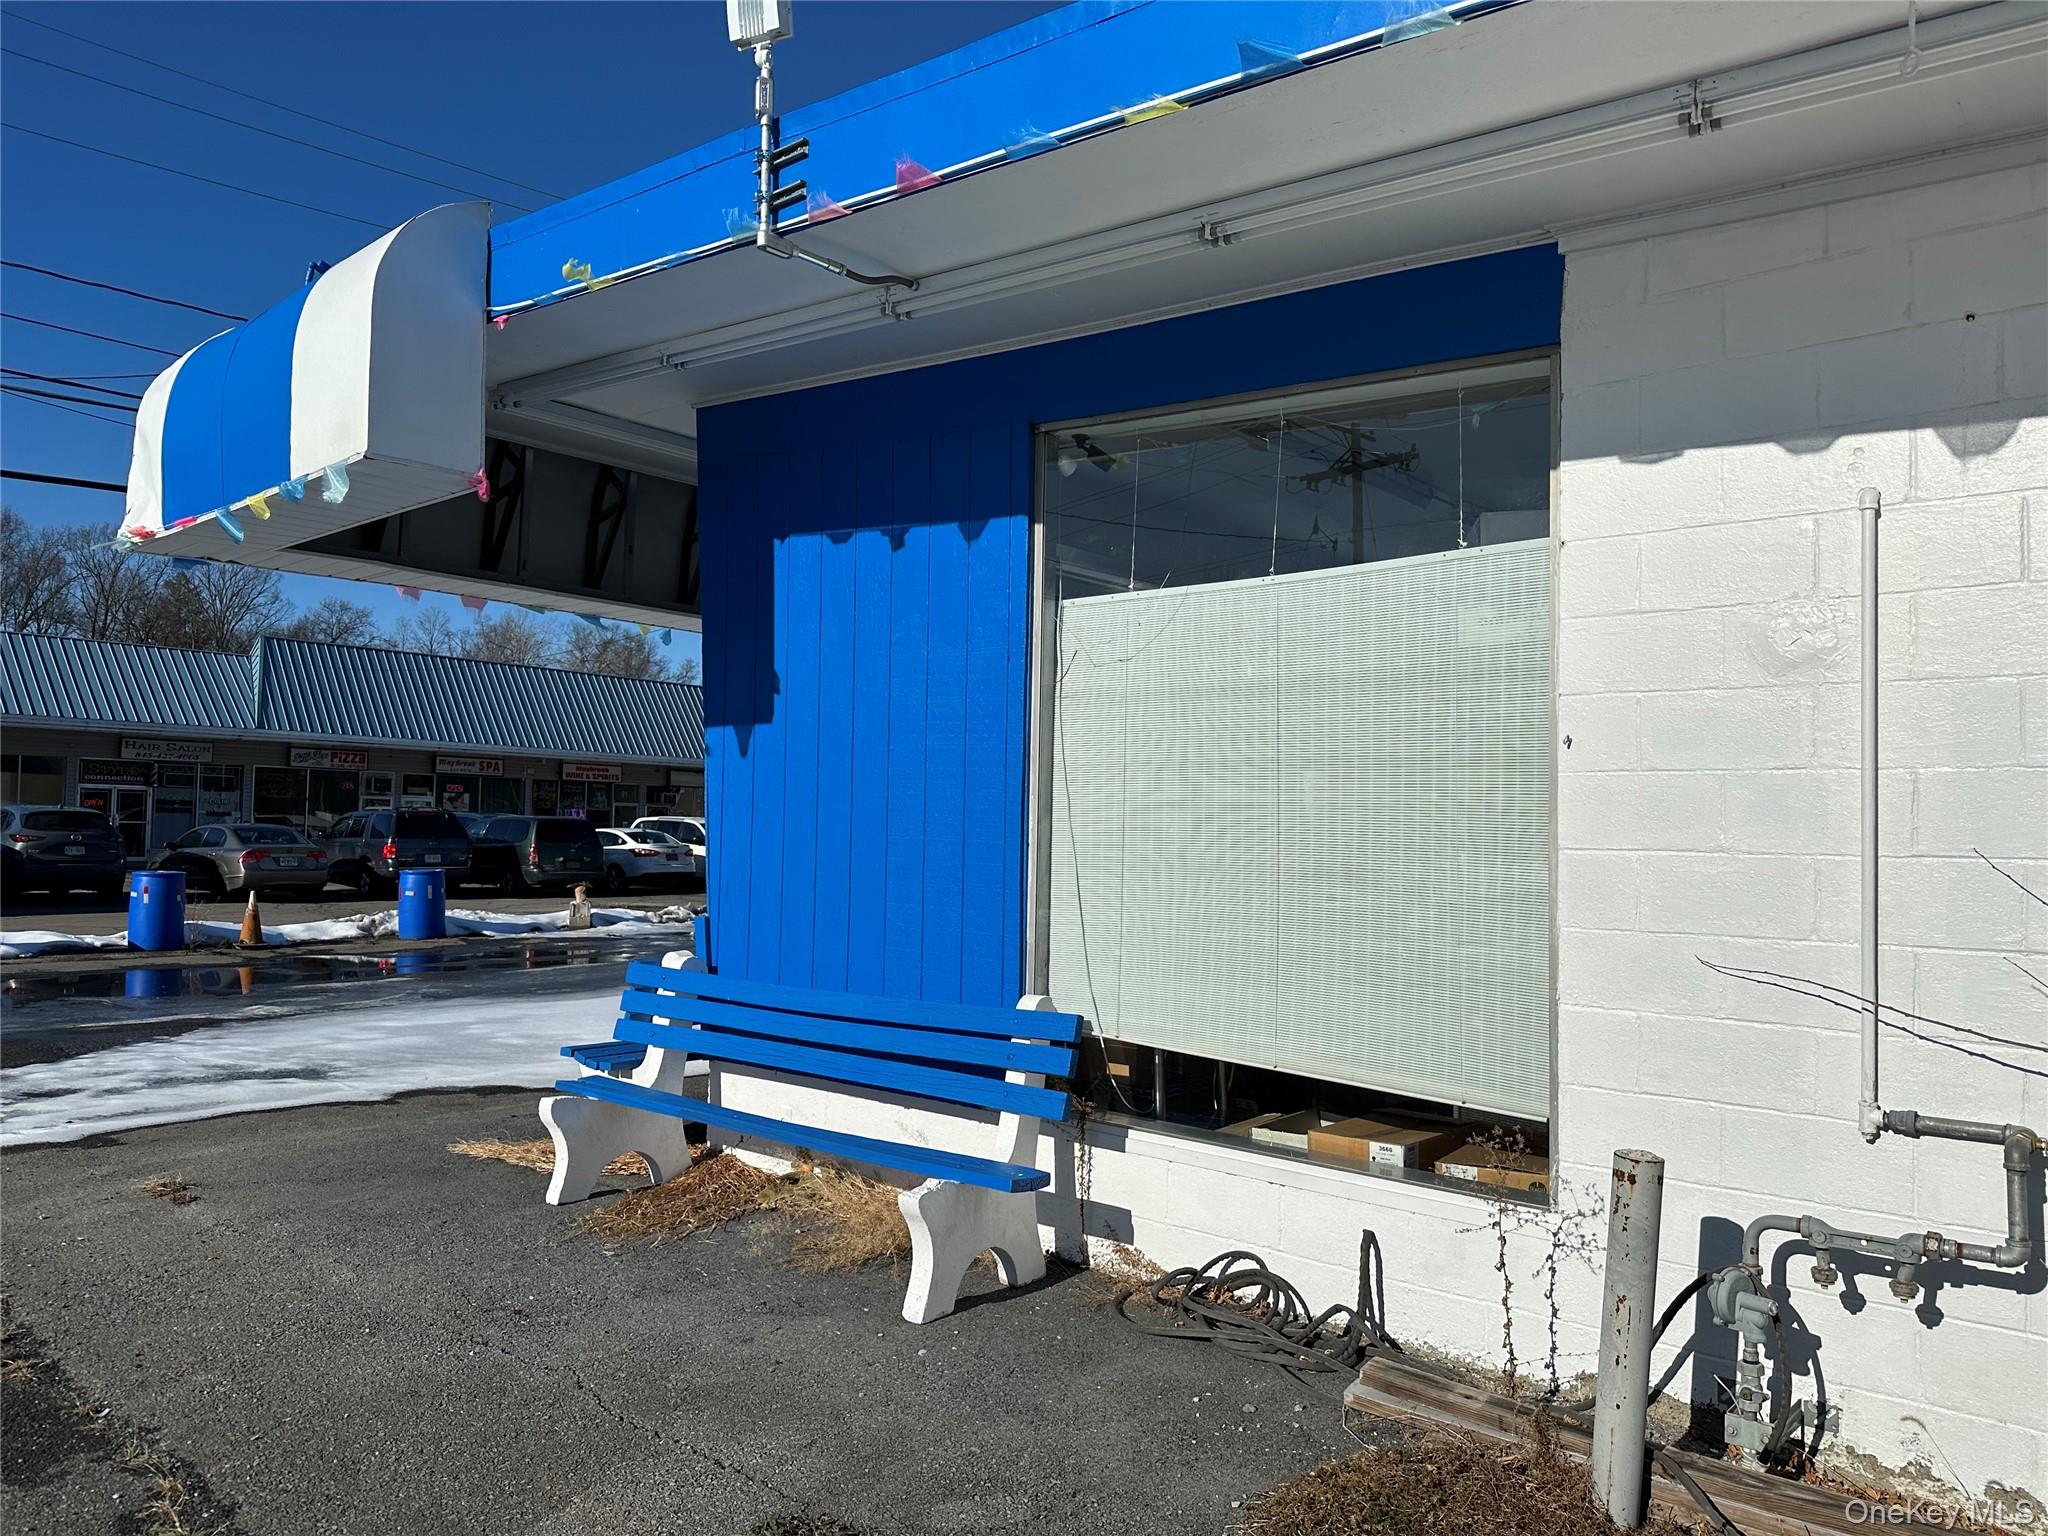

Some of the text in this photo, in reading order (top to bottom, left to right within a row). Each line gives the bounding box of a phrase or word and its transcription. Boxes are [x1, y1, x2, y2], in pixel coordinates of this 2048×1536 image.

[479, 760, 500, 772] SPA
[84, 774, 145, 782] connection
[83, 799, 105, 808] OPEN
